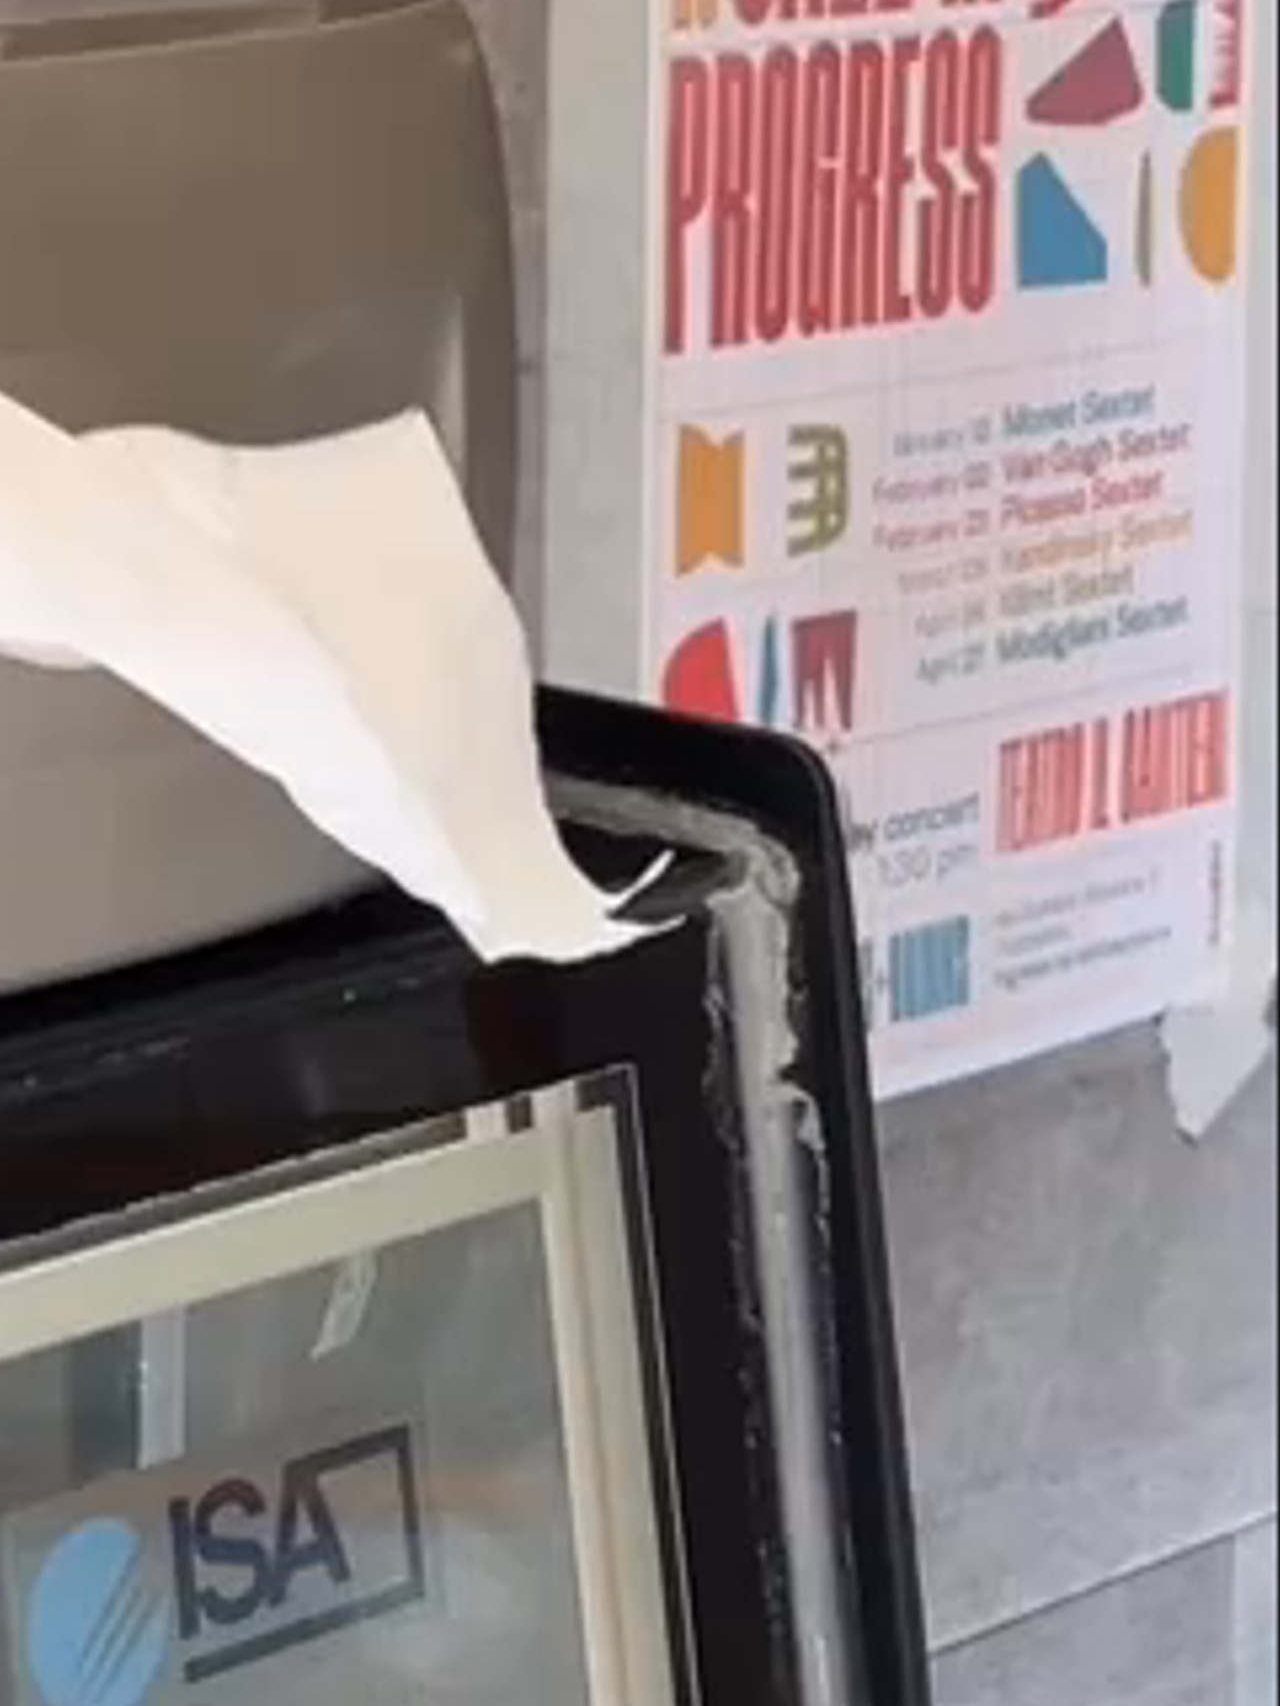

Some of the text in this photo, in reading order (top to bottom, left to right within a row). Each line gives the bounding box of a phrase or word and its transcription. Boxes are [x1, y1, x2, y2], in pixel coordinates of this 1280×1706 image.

[662, 24, 1004, 356] PROGRESS
[1081, 384, 1155, 425] Sextet
[1118, 422, 1192, 462] Sextet
[1092, 468, 1162, 511] Sextet
[1118, 595, 1188, 637] Sextet
[166, 1470, 351, 1641] ISA
